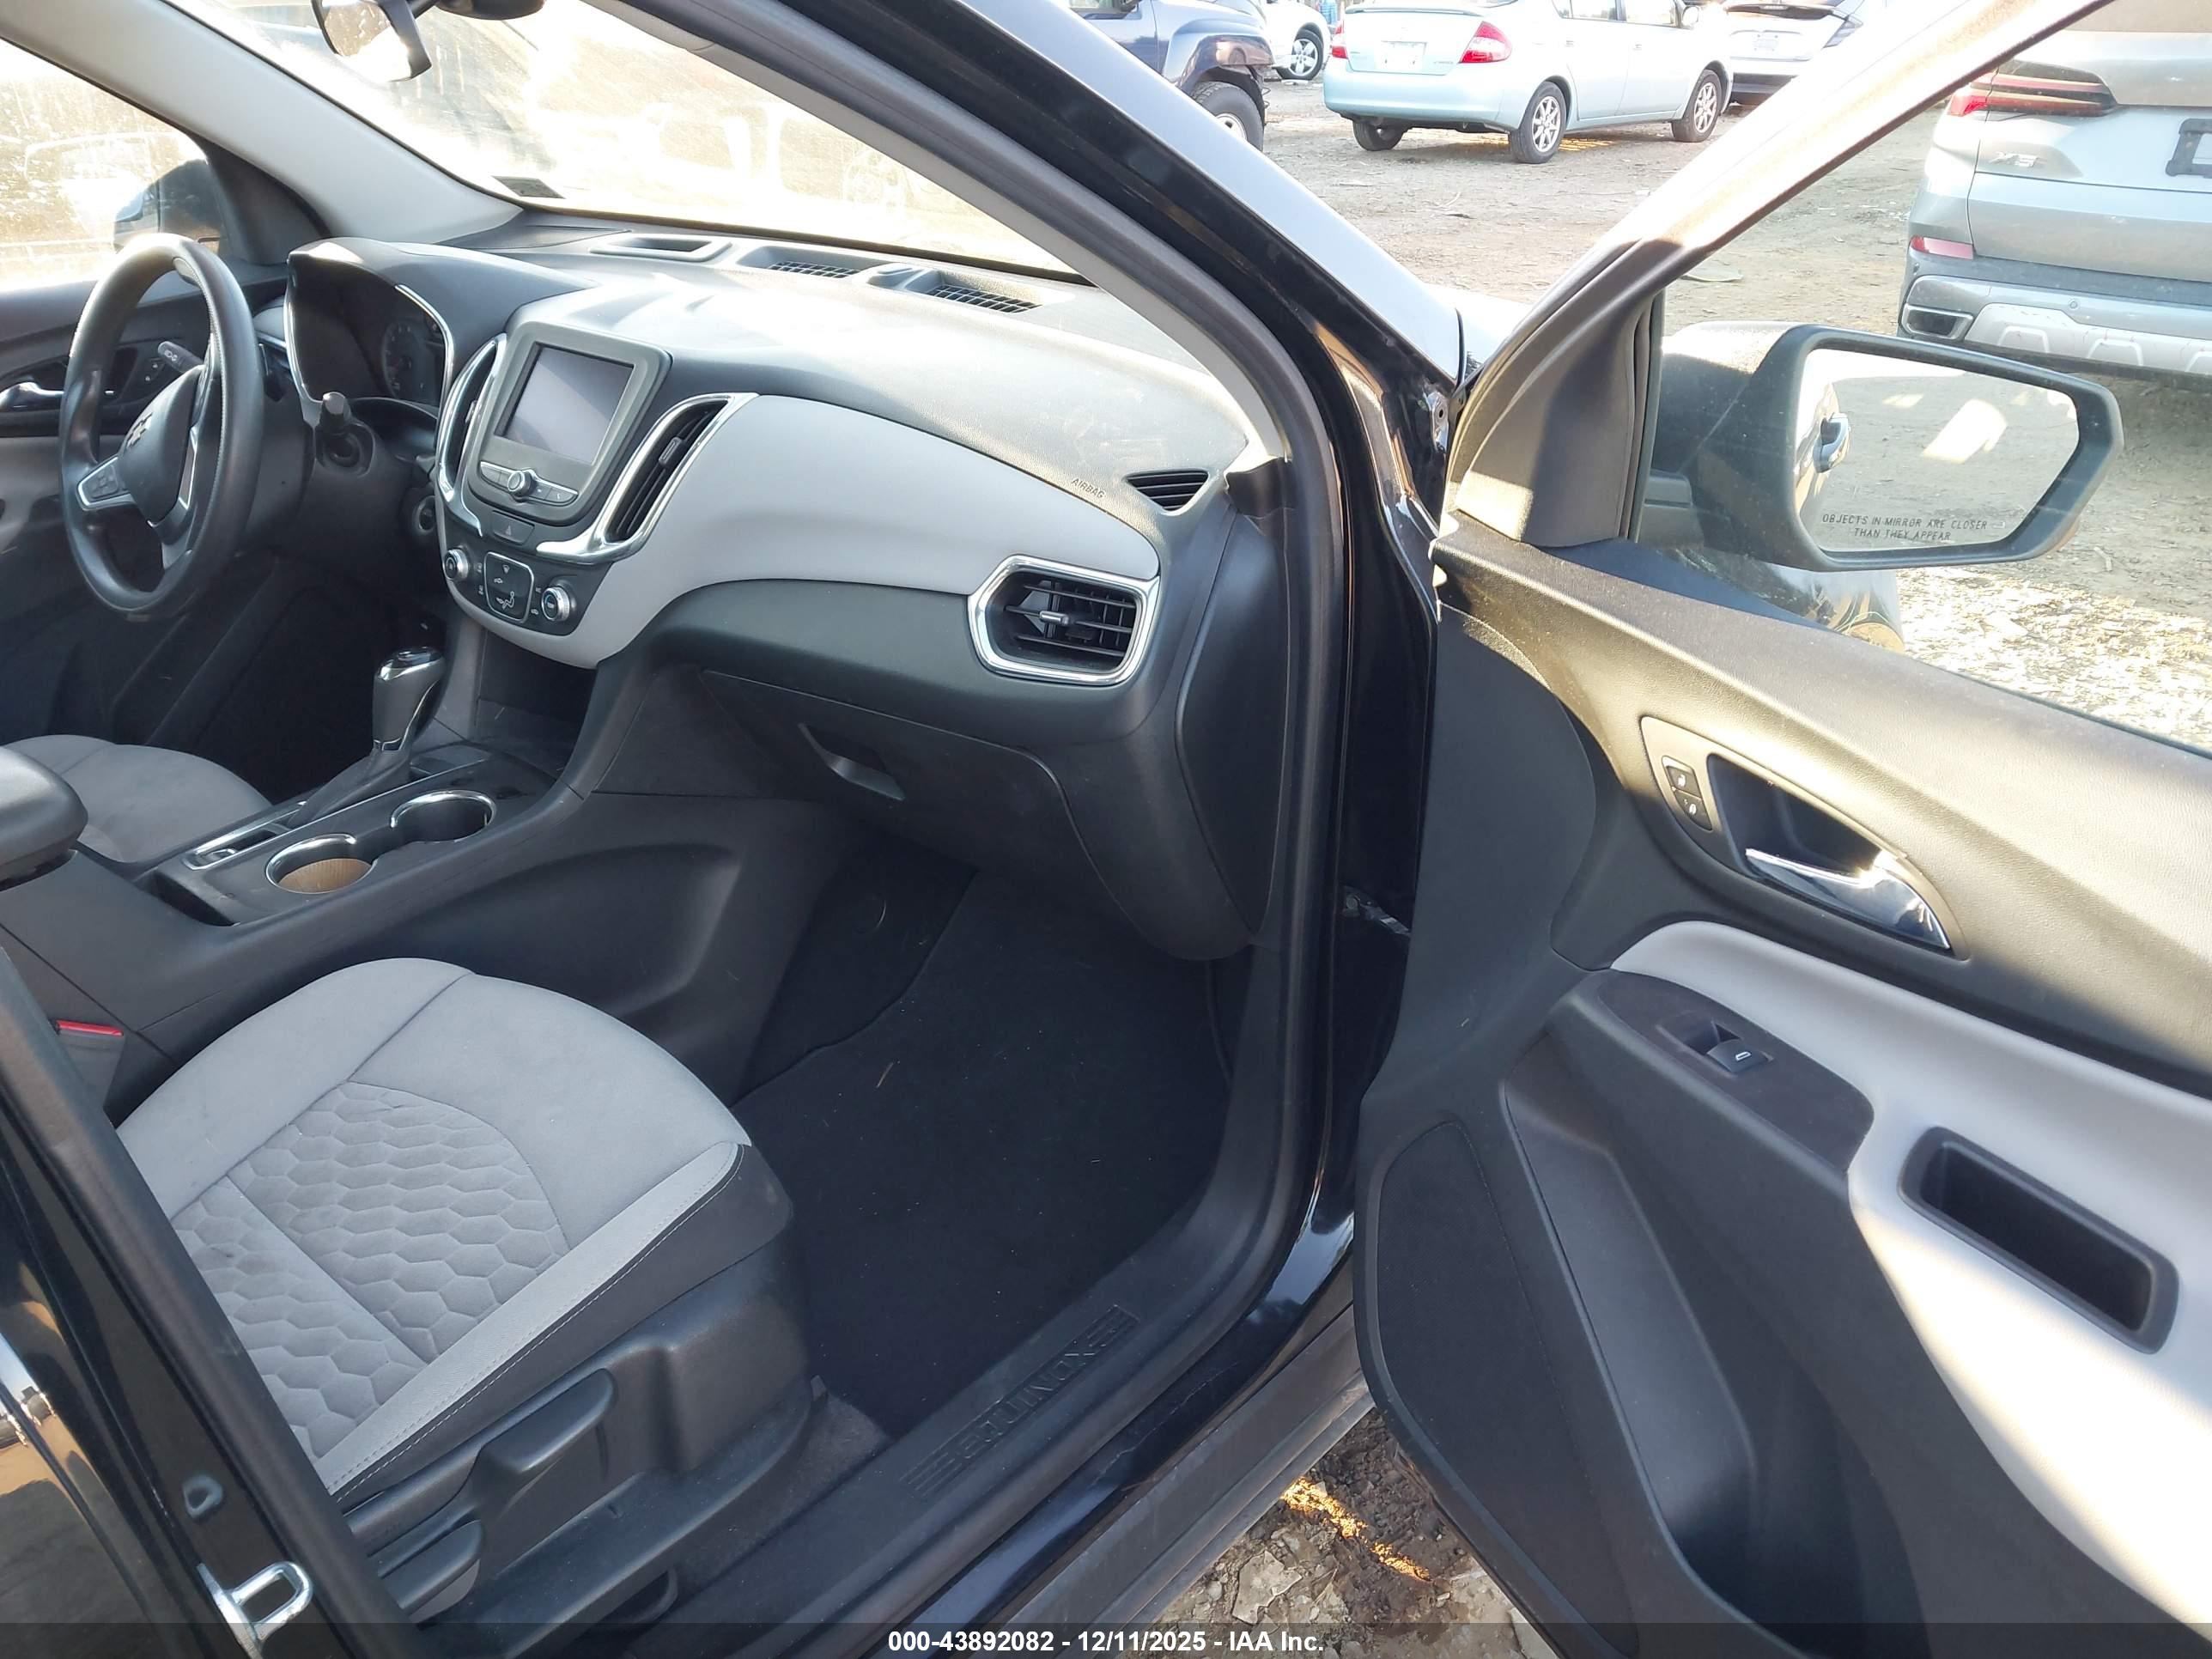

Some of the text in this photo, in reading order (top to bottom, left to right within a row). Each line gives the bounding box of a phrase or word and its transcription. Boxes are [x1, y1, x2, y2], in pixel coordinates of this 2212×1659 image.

[1071, 477, 1105, 499] AIRBAG
[1822, 514, 1988, 530] OBJECTS IN MIRROR ARE CLOSER
[1854, 527, 1951, 541] THAN THEY APPEAR
[959, 1341, 1096, 1460] EQUINOX
